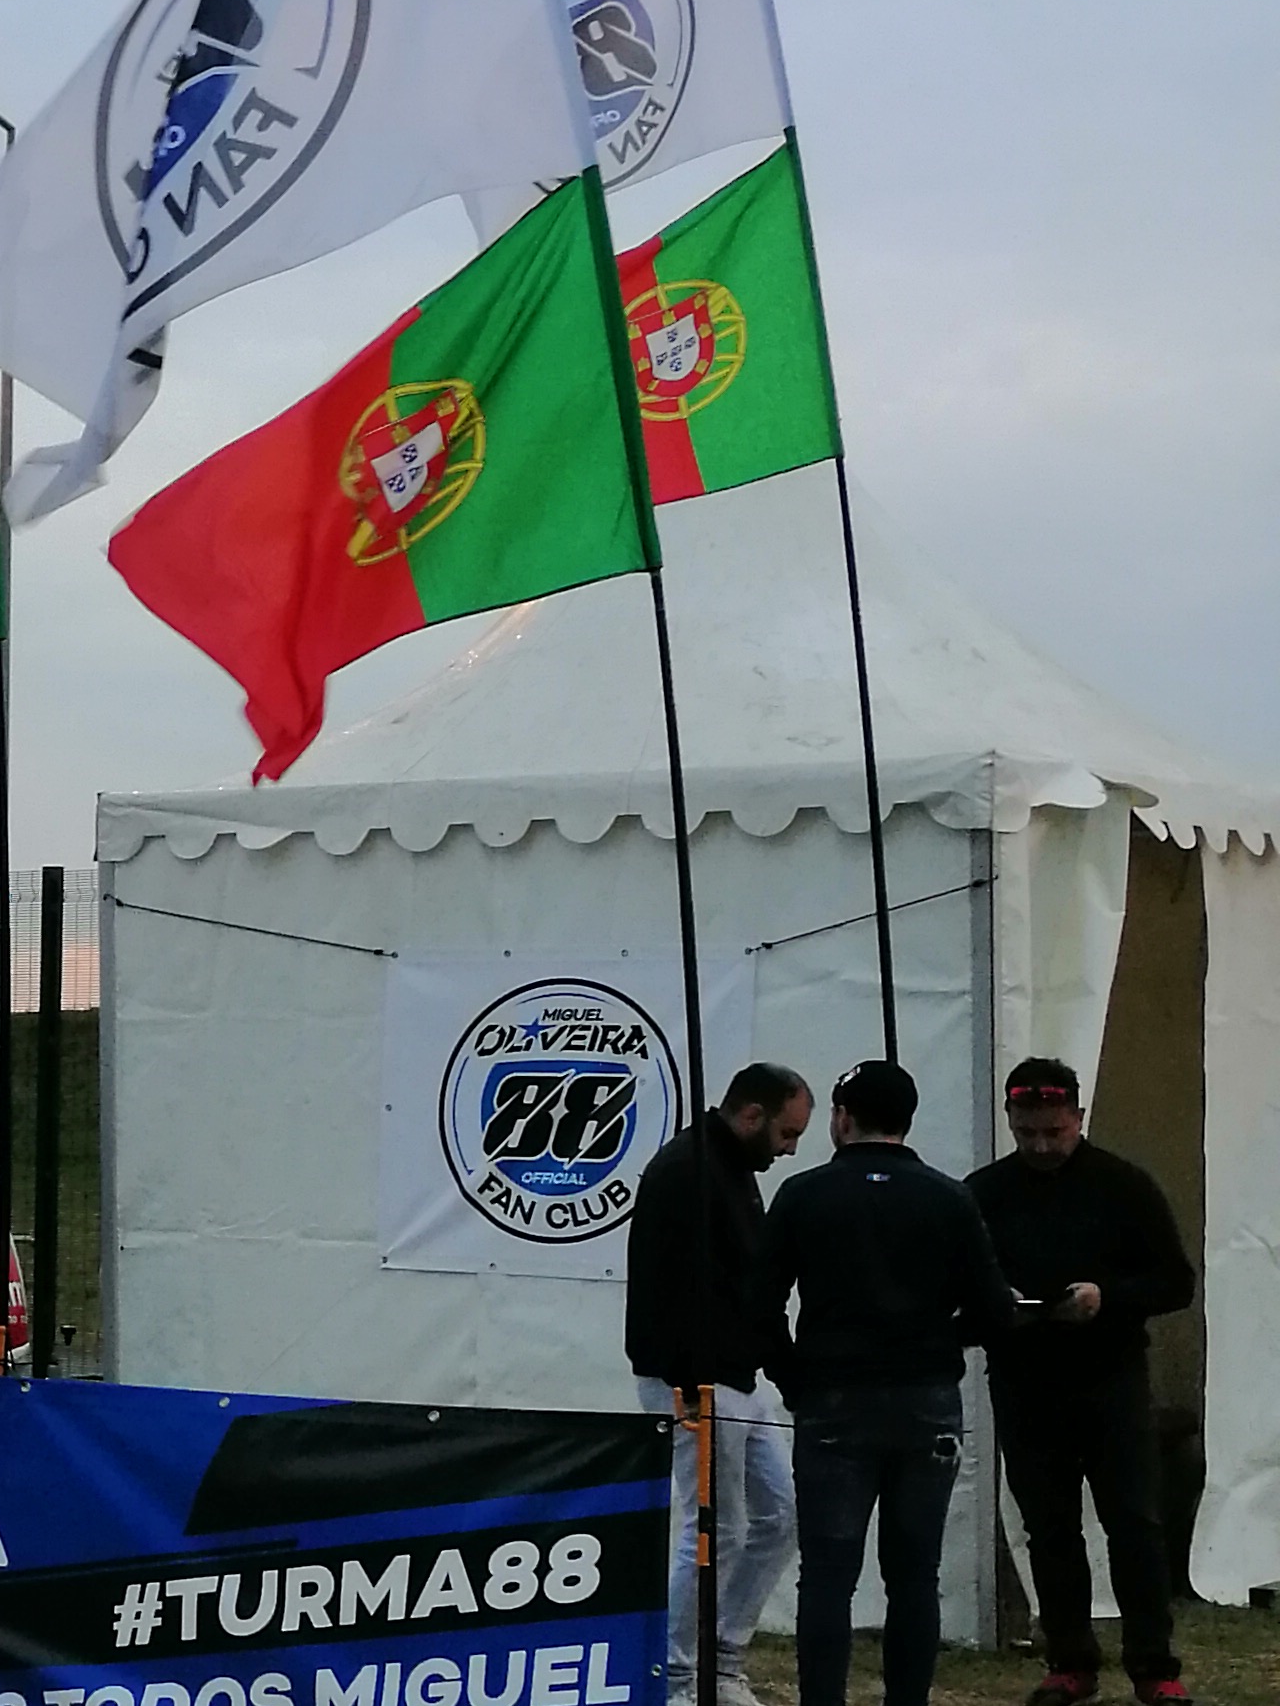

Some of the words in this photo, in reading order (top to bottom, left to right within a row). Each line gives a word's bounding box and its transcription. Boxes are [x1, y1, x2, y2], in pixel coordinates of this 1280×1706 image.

[541, 1008, 604, 1023] MIGUEL
[474, 1024, 650, 1060] OLIVEIRA
[481, 1069, 639, 1168] 88
[477, 1171, 537, 1226] FAN
[546, 1179, 632, 1229] CLUB
[521, 1170, 588, 1186] OFFICIAL
[113, 1533, 602, 1647] #TURMA88
